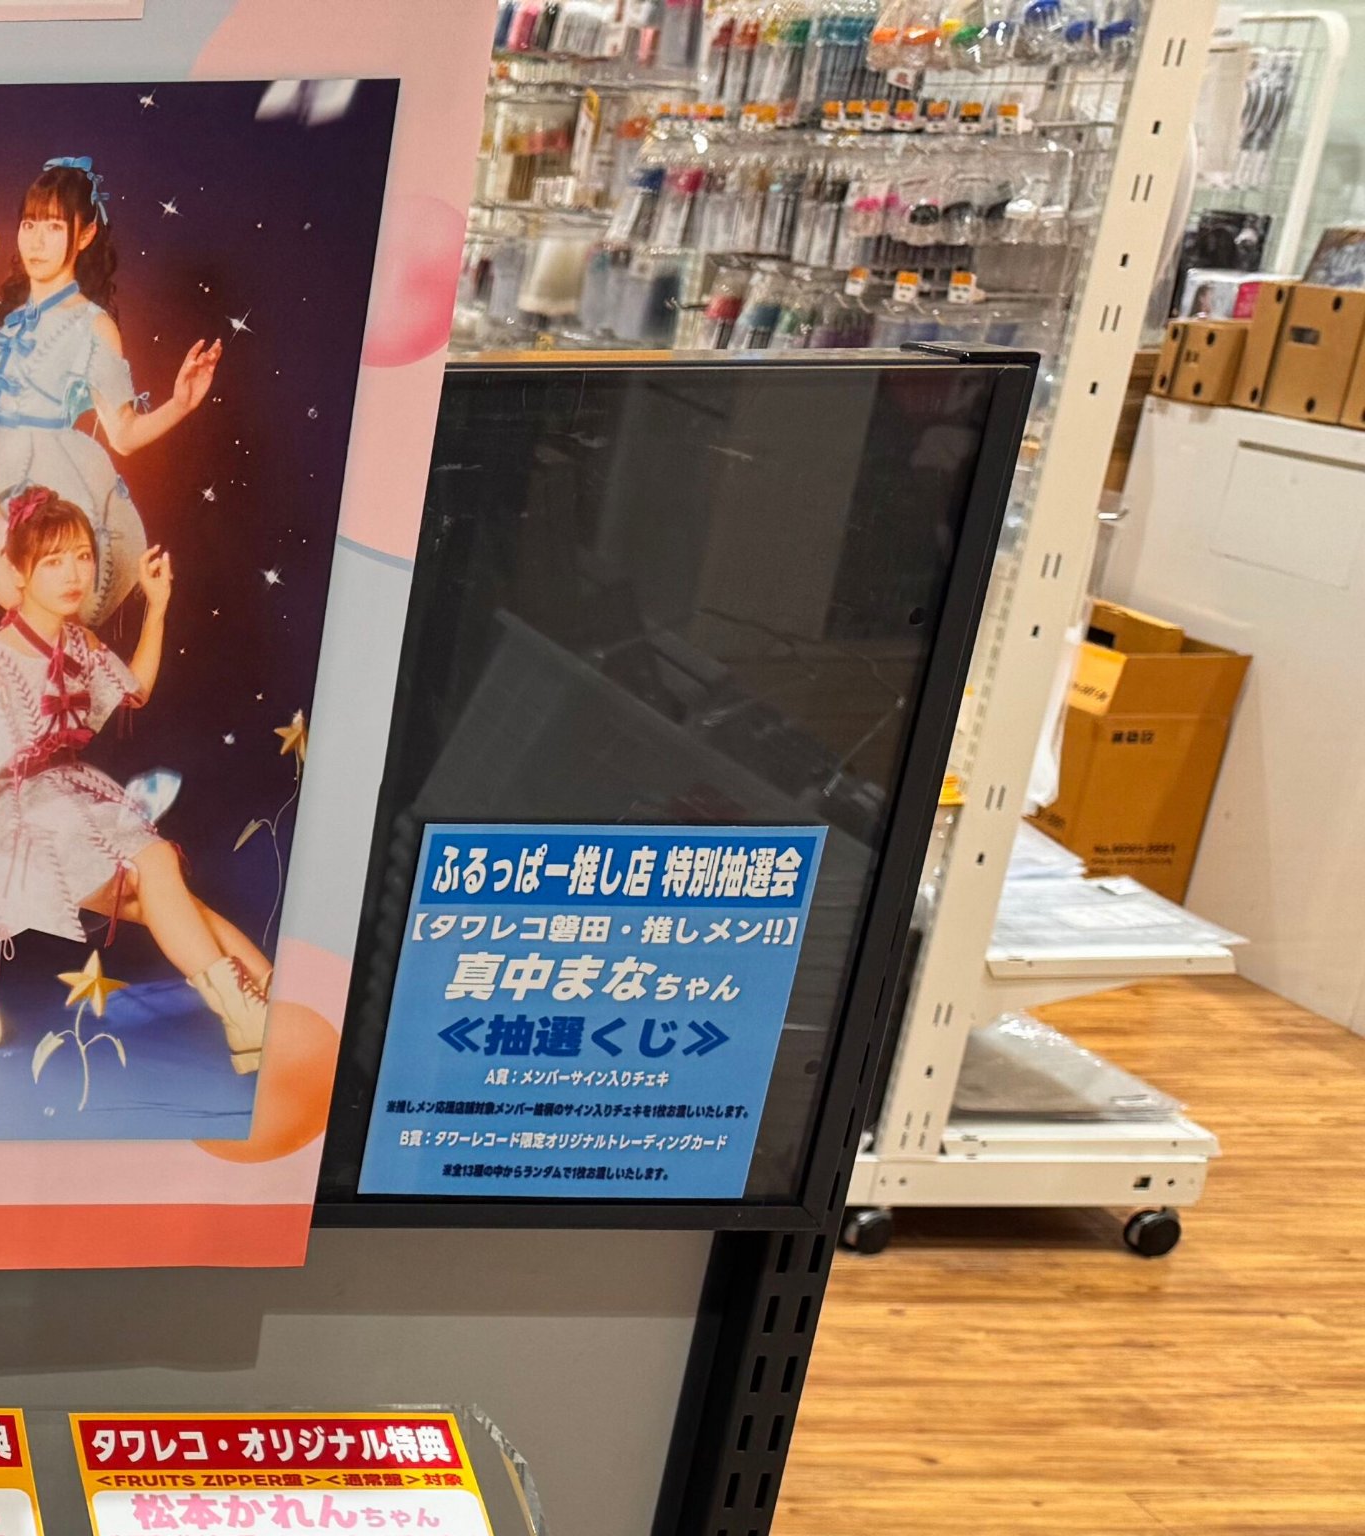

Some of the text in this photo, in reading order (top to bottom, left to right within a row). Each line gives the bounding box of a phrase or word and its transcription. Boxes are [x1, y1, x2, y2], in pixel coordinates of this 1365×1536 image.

[431, 843, 804, 899] ふるっぱー推し店 特別抽選会
[444, 952, 741, 1002] 真中まなちゃん
[91, 1426, 451, 1463] タワレコ・オリジナル特典
[131, 1494, 440, 1530] 松本かれんちゃん
